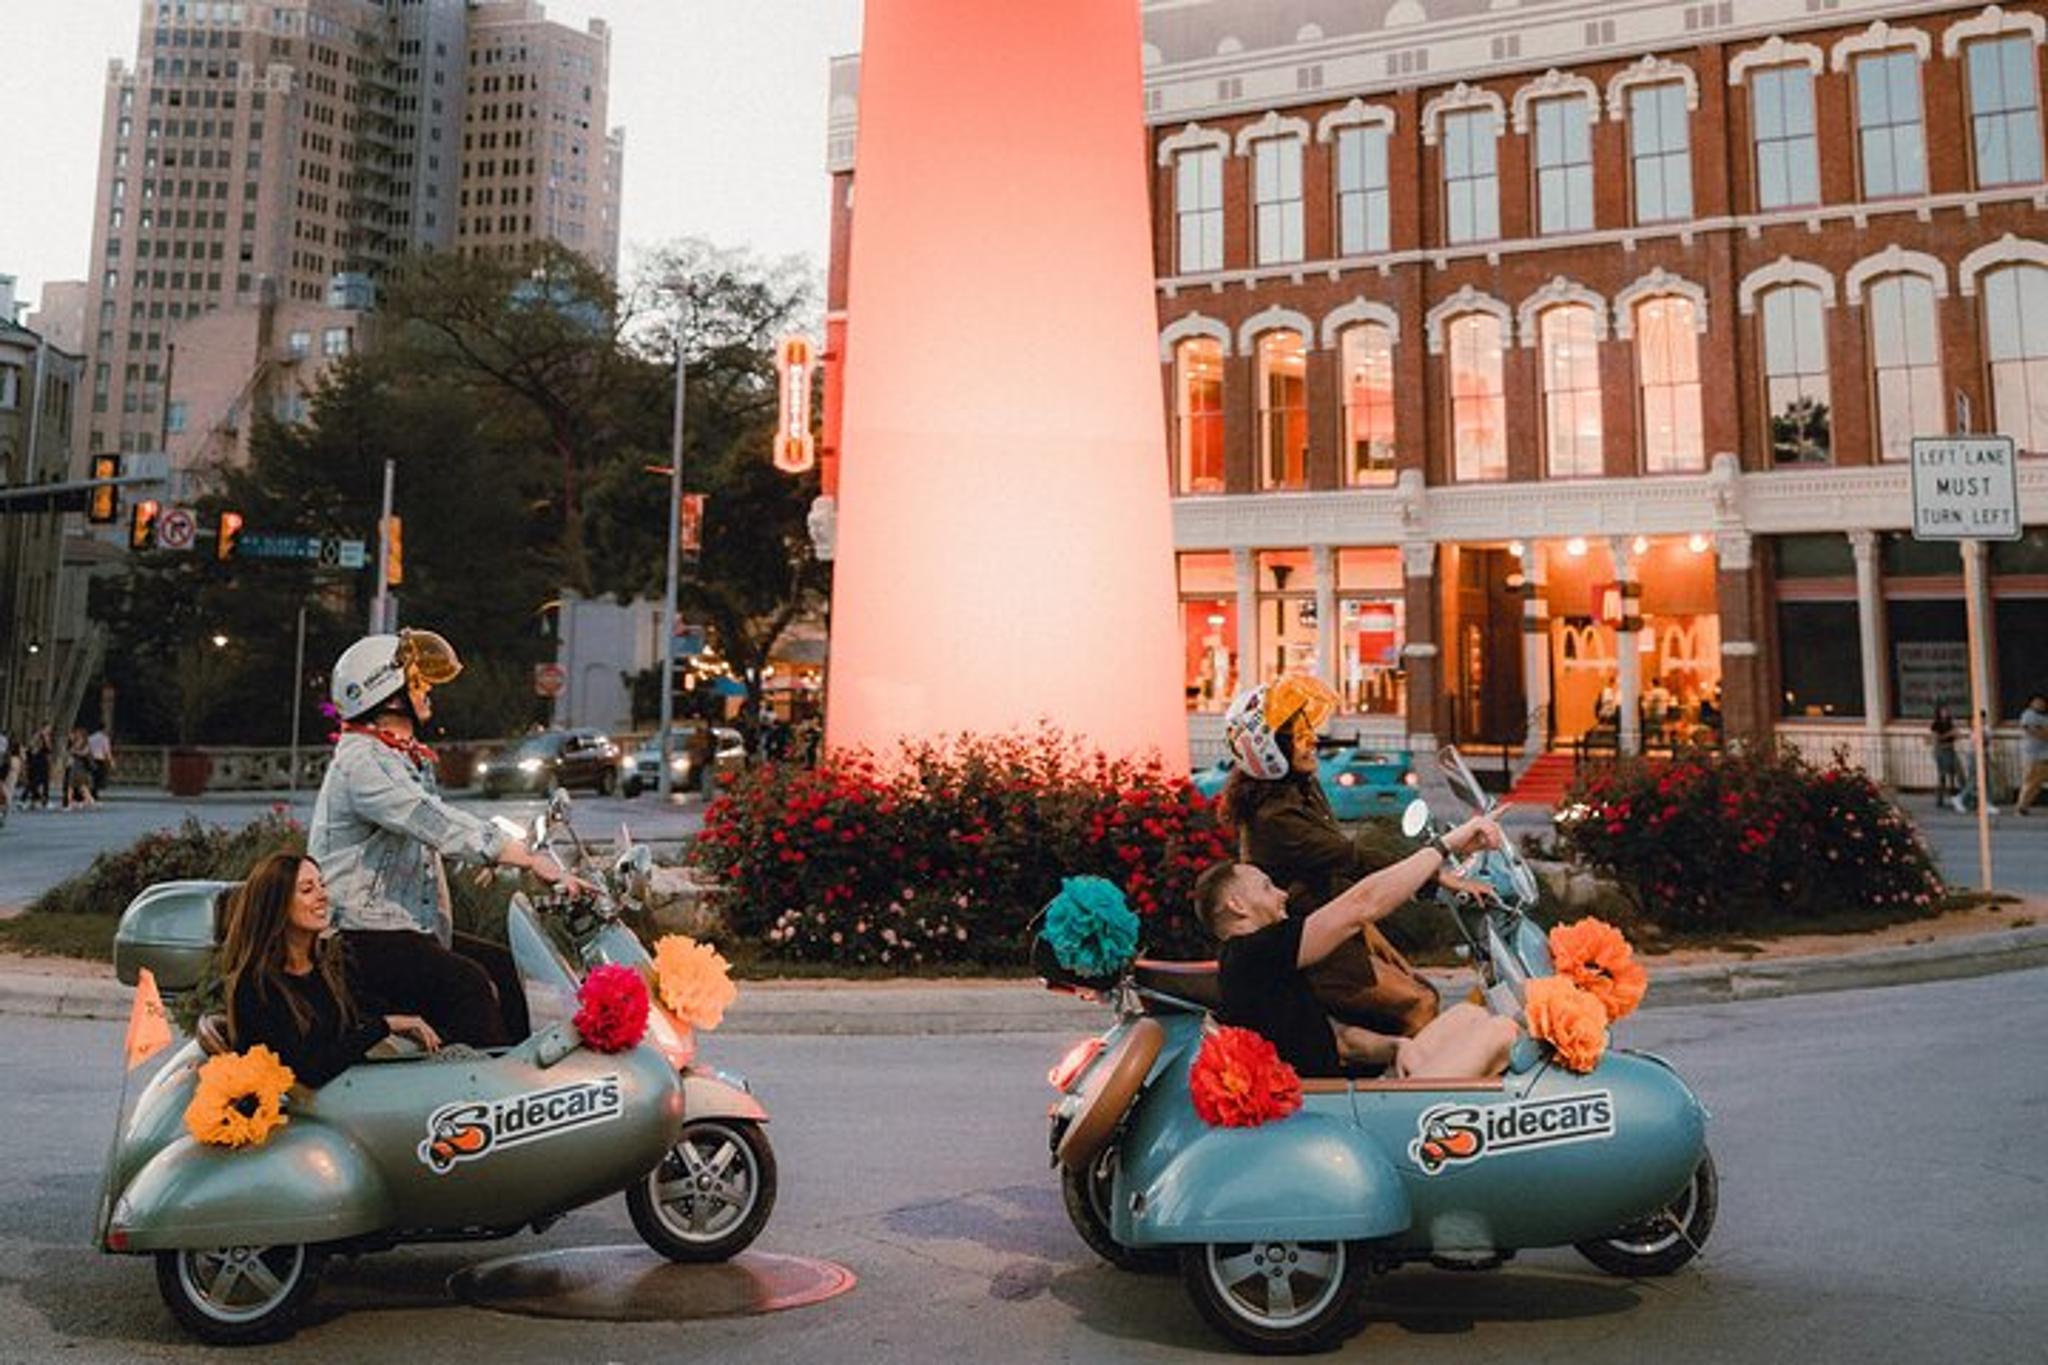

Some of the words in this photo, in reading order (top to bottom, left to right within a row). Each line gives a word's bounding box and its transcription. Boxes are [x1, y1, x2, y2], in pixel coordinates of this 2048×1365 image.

[1919, 449, 1956, 466] LEFT
[1965, 449, 2005, 466] LANE
[1936, 476, 1991, 496] MUST
[1922, 508, 1962, 525] TURN
[1973, 508, 2011, 524] LEFT
[430, 1083, 619, 1169] Sidecars
[1419, 1099, 1611, 1170] Sidecars
